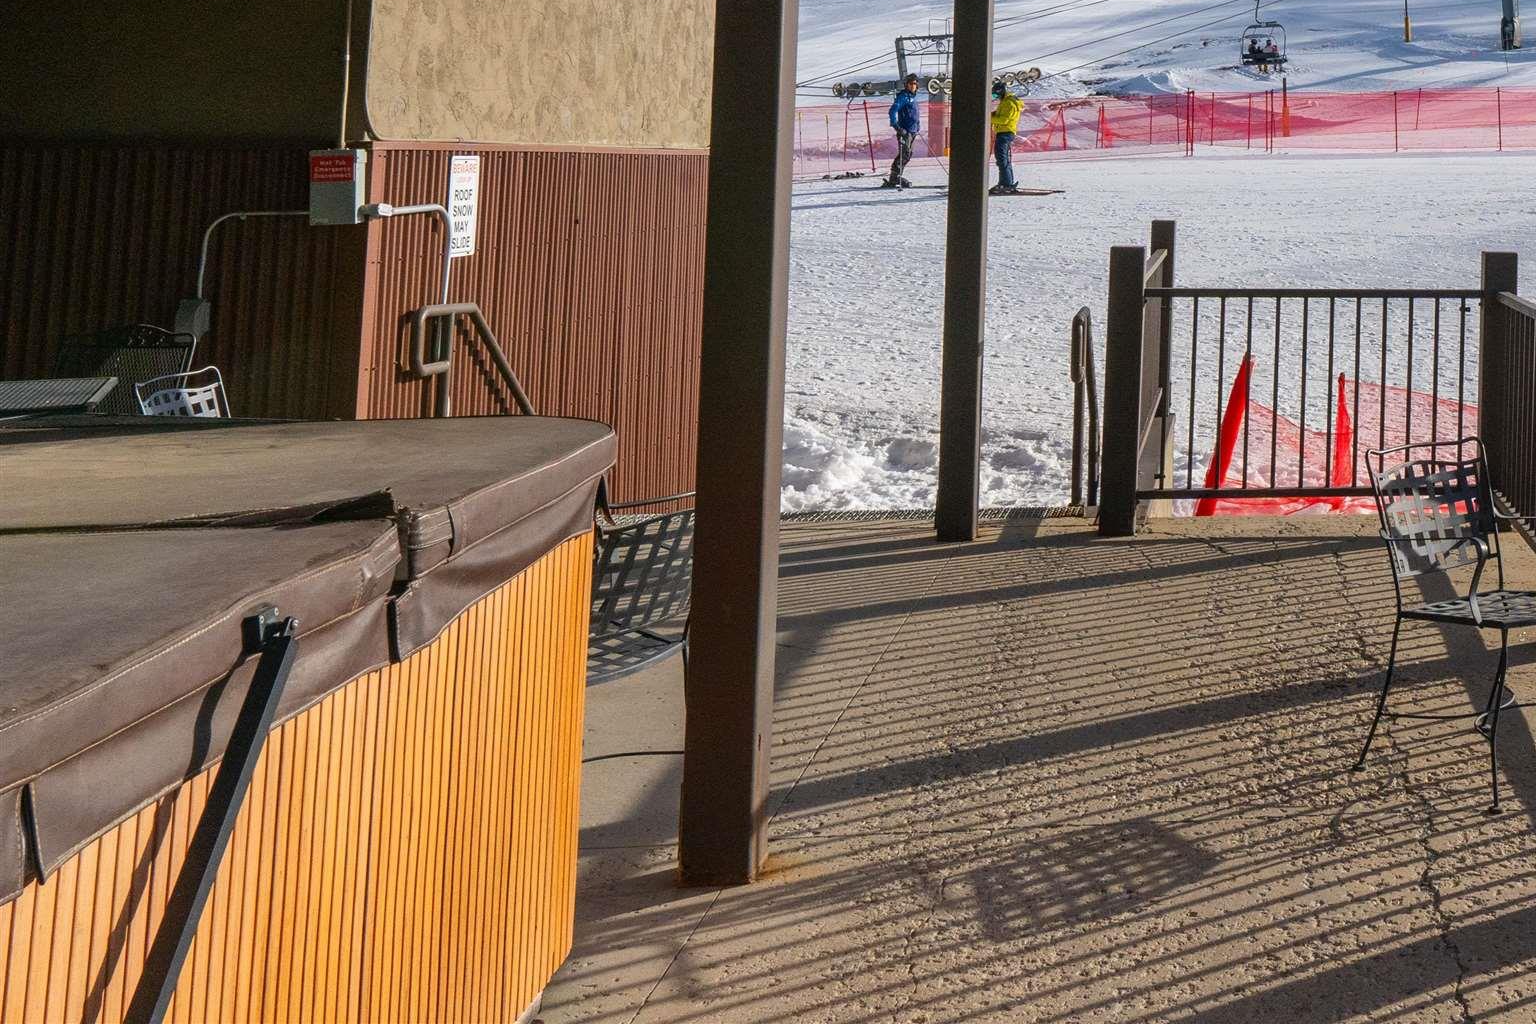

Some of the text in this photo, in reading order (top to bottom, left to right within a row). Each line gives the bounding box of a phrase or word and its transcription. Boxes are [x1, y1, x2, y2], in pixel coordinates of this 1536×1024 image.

[453, 162, 478, 174] BEWARE
[454, 188, 473, 201] ROOF
[452, 205, 474, 216] SNOW
[454, 220, 468, 232] MAY
[451, 236, 471, 249] SLIDE
